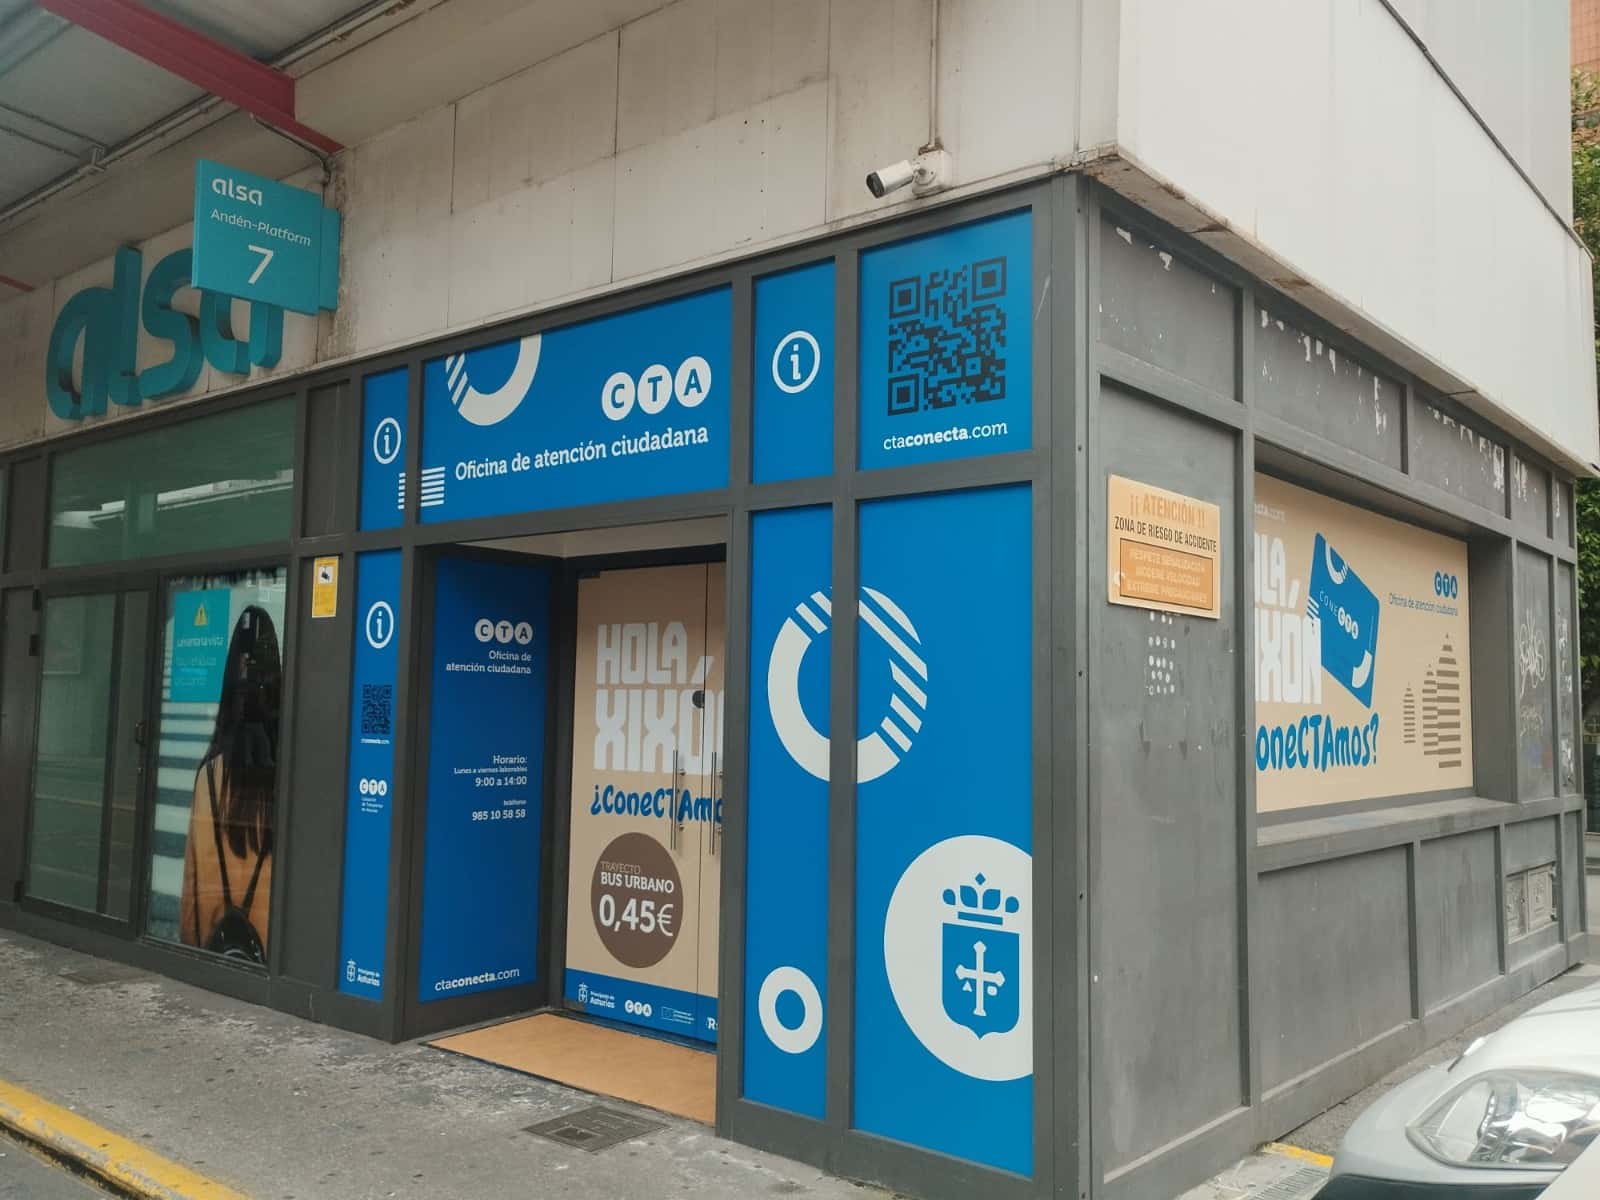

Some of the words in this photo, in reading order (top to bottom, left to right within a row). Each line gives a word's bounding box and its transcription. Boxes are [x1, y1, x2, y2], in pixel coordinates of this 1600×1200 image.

[211, 178, 263, 207] alsa
[210, 208, 311, 247] Andén-Platform
[247, 244, 274, 285] 7
[606, 361, 707, 415] CTA
[883, 422, 1008, 450] ctaconecta.com
[455, 459, 508, 481] Oficina
[511, 453, 531, 473] de
[534, 440, 607, 469] atención
[611, 427, 709, 457] ciudadana
[1114, 515, 1135, 534] ZONA
[1137, 520, 1147, 536] DE
[1148, 523, 1173, 543] RIESGO
[1174, 529, 1184, 546] DE
[1185, 532, 1217, 553] ACCIDENTE
[476, 620, 532, 643] CTA
[446, 662, 485, 673] atención
[487, 664, 532, 675] ciudadana
[488, 650, 519, 661] Oficina
[521, 652, 532, 662] de
[475, 777, 495, 787] 9:00
[504, 776, 528, 786] 14:00
[472, 811, 489, 821] 985
[491, 810, 501, 820] 10
[601, 871, 623, 887] BUS
[624, 874, 675, 894] URBANO
[599, 894, 674, 937] 0,45€
[434, 966, 520, 992] ctaconecta.com
